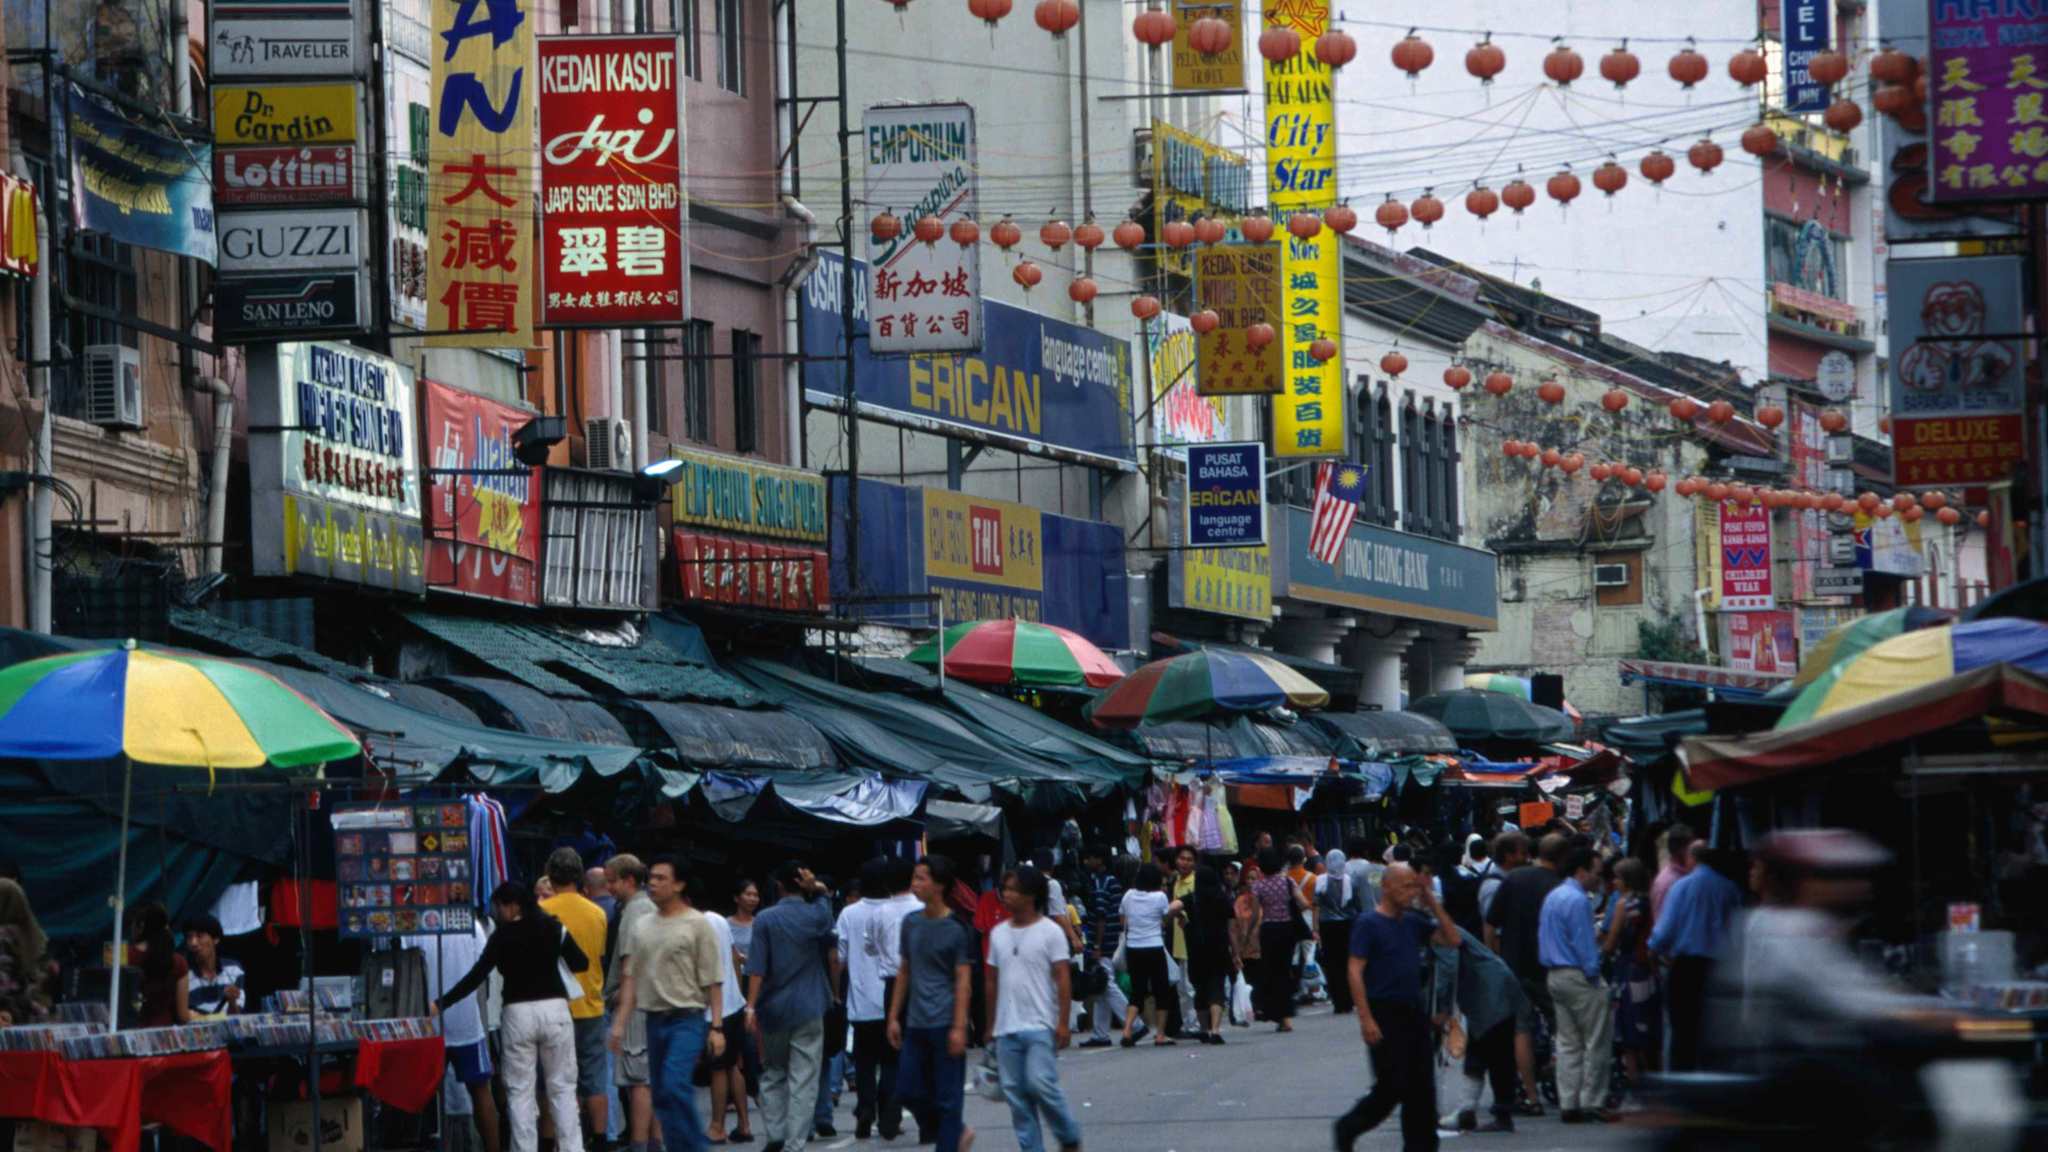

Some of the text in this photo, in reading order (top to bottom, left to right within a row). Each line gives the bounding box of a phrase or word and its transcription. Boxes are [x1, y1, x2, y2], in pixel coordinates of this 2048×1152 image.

[258, 38, 349, 61] TRAVELLER
[542, 50, 674, 93] KEDAI KASUT
[234, 114, 333, 143] Cardin
[869, 122, 966, 165] EMPORIUM
[1269, 114, 1331, 155] City
[224, 146, 347, 188] Lottini
[1271, 158, 1332, 193] Star
[545, 183, 677, 214] JAPI SHOE SDN BHD
[222, 225, 351, 260] GUZZI
[440, 154, 519, 334] 大減價
[1202, 254, 1236, 277] KEDAI
[874, 266, 971, 302] 新加坡
[875, 310, 969, 338] 百貨公司
[1041, 323, 1086, 388] language
[1086, 347, 1119, 387] centre
[1914, 418, 2001, 444] DELUXE
[1199, 466, 1248, 478] BAHASA
[1205, 453, 1242, 466] PUSAT
[1200, 514, 1251, 527] language
[1207, 525, 1245, 537] centre
[1374, 543, 1403, 587] LEONG
[1404, 549, 1430, 591] BANK
